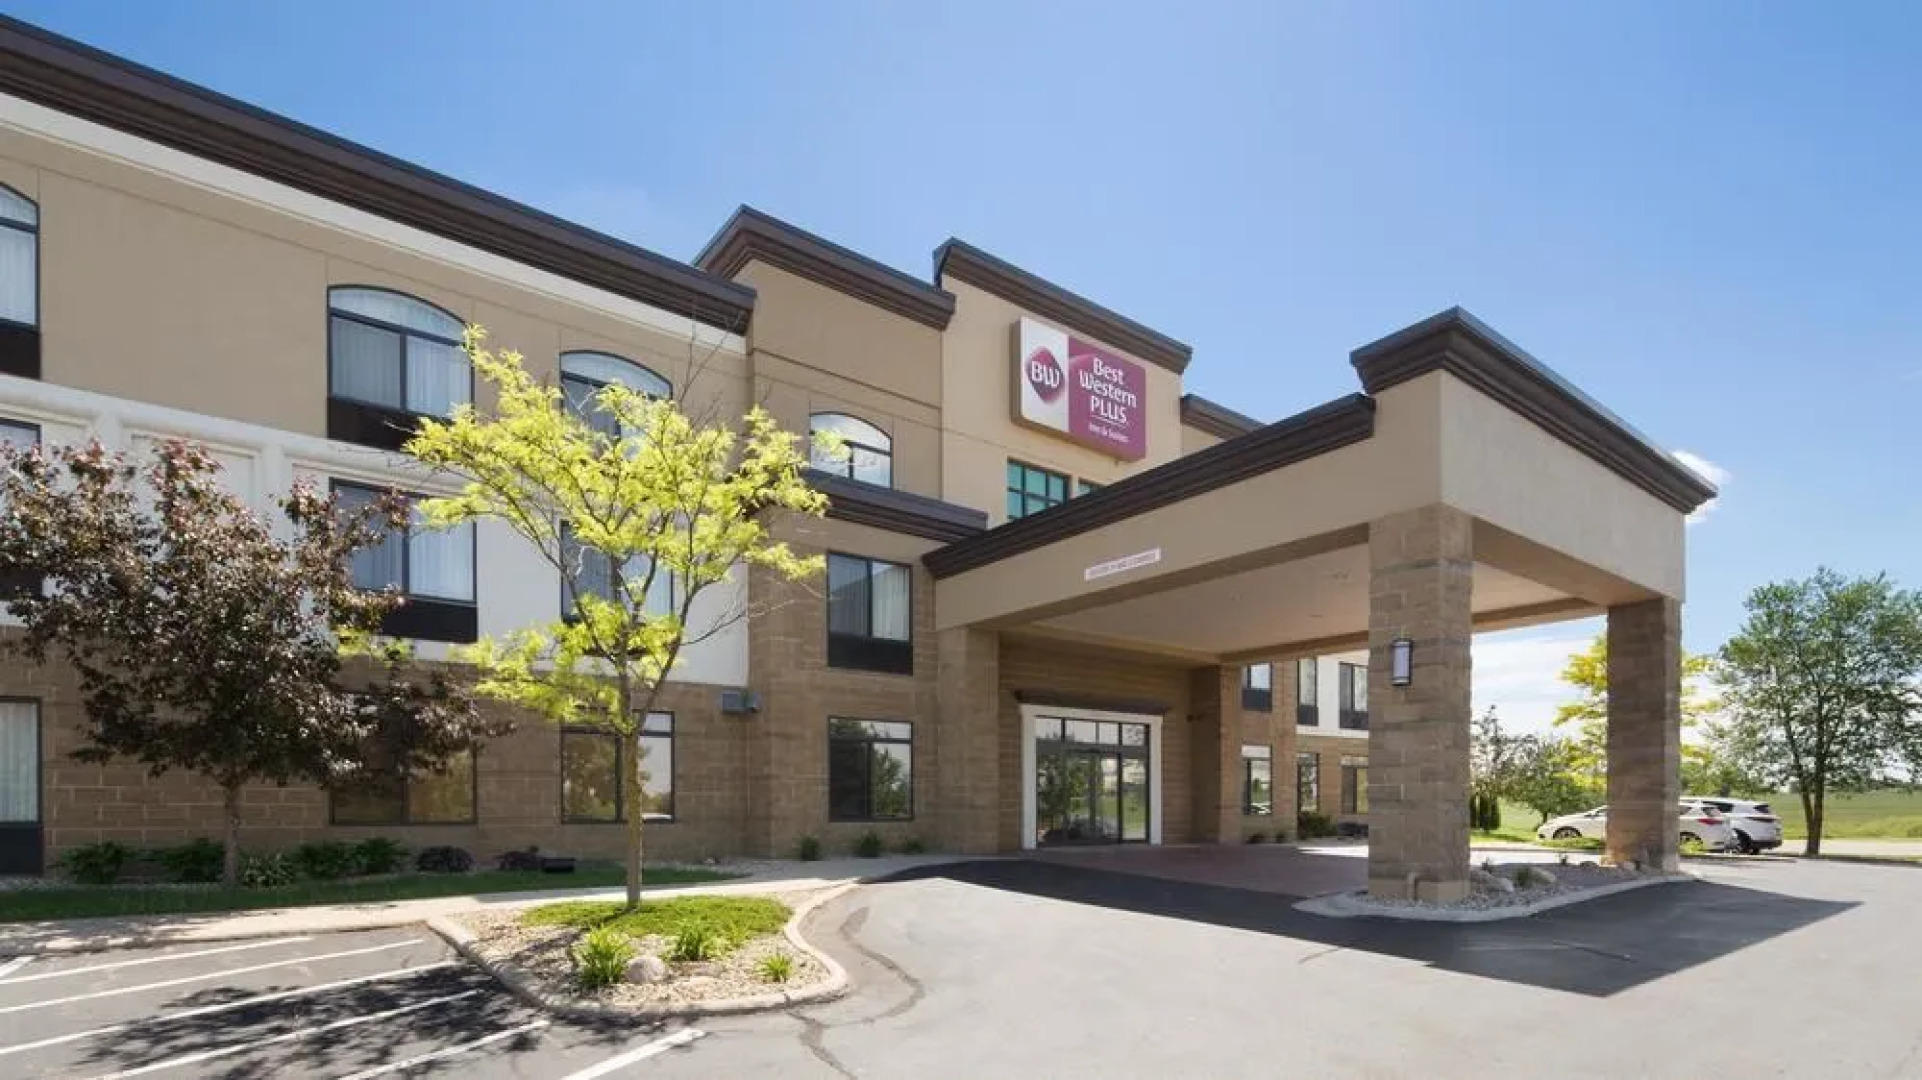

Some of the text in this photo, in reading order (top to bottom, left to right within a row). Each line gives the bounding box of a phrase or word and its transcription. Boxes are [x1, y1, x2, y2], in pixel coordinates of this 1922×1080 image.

[1031, 361, 1060, 387] BW
[1093, 357, 1124, 385] Best
[1079, 369, 1137, 408] Western
[1091, 395, 1127, 422] PLUS
